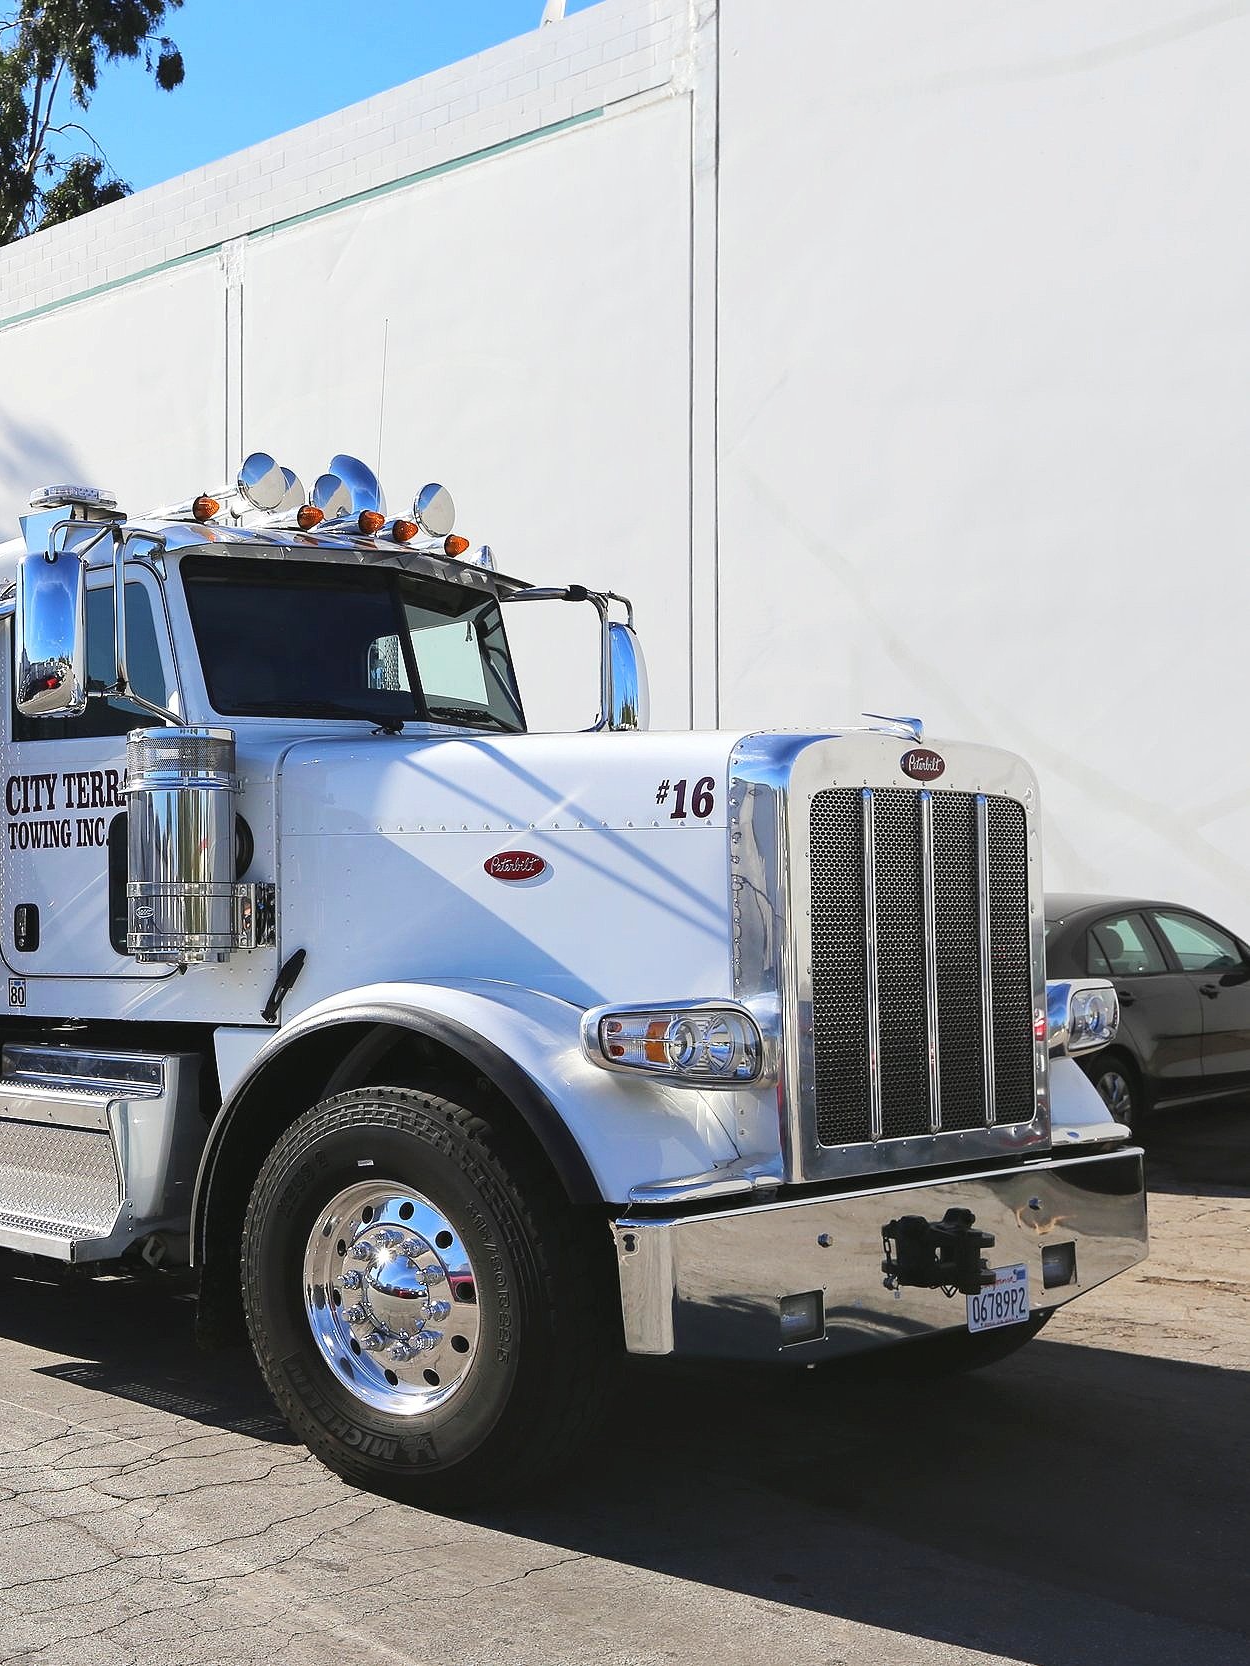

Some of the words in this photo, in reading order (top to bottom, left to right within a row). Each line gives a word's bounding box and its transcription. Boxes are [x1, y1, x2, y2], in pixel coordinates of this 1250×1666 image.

[908, 753, 943, 772] Peterbilt
[5, 773, 58, 816] CITY
[655, 776, 716, 820] #16
[7, 818, 72, 850] TOWING
[76, 817, 110, 848] INC.
[490, 856, 541, 874] Peterbilt
[10, 986, 25, 1004] 80
[972, 1286, 1026, 1323] 06789P2
[285, 1361, 399, 1461] MICHELIN
